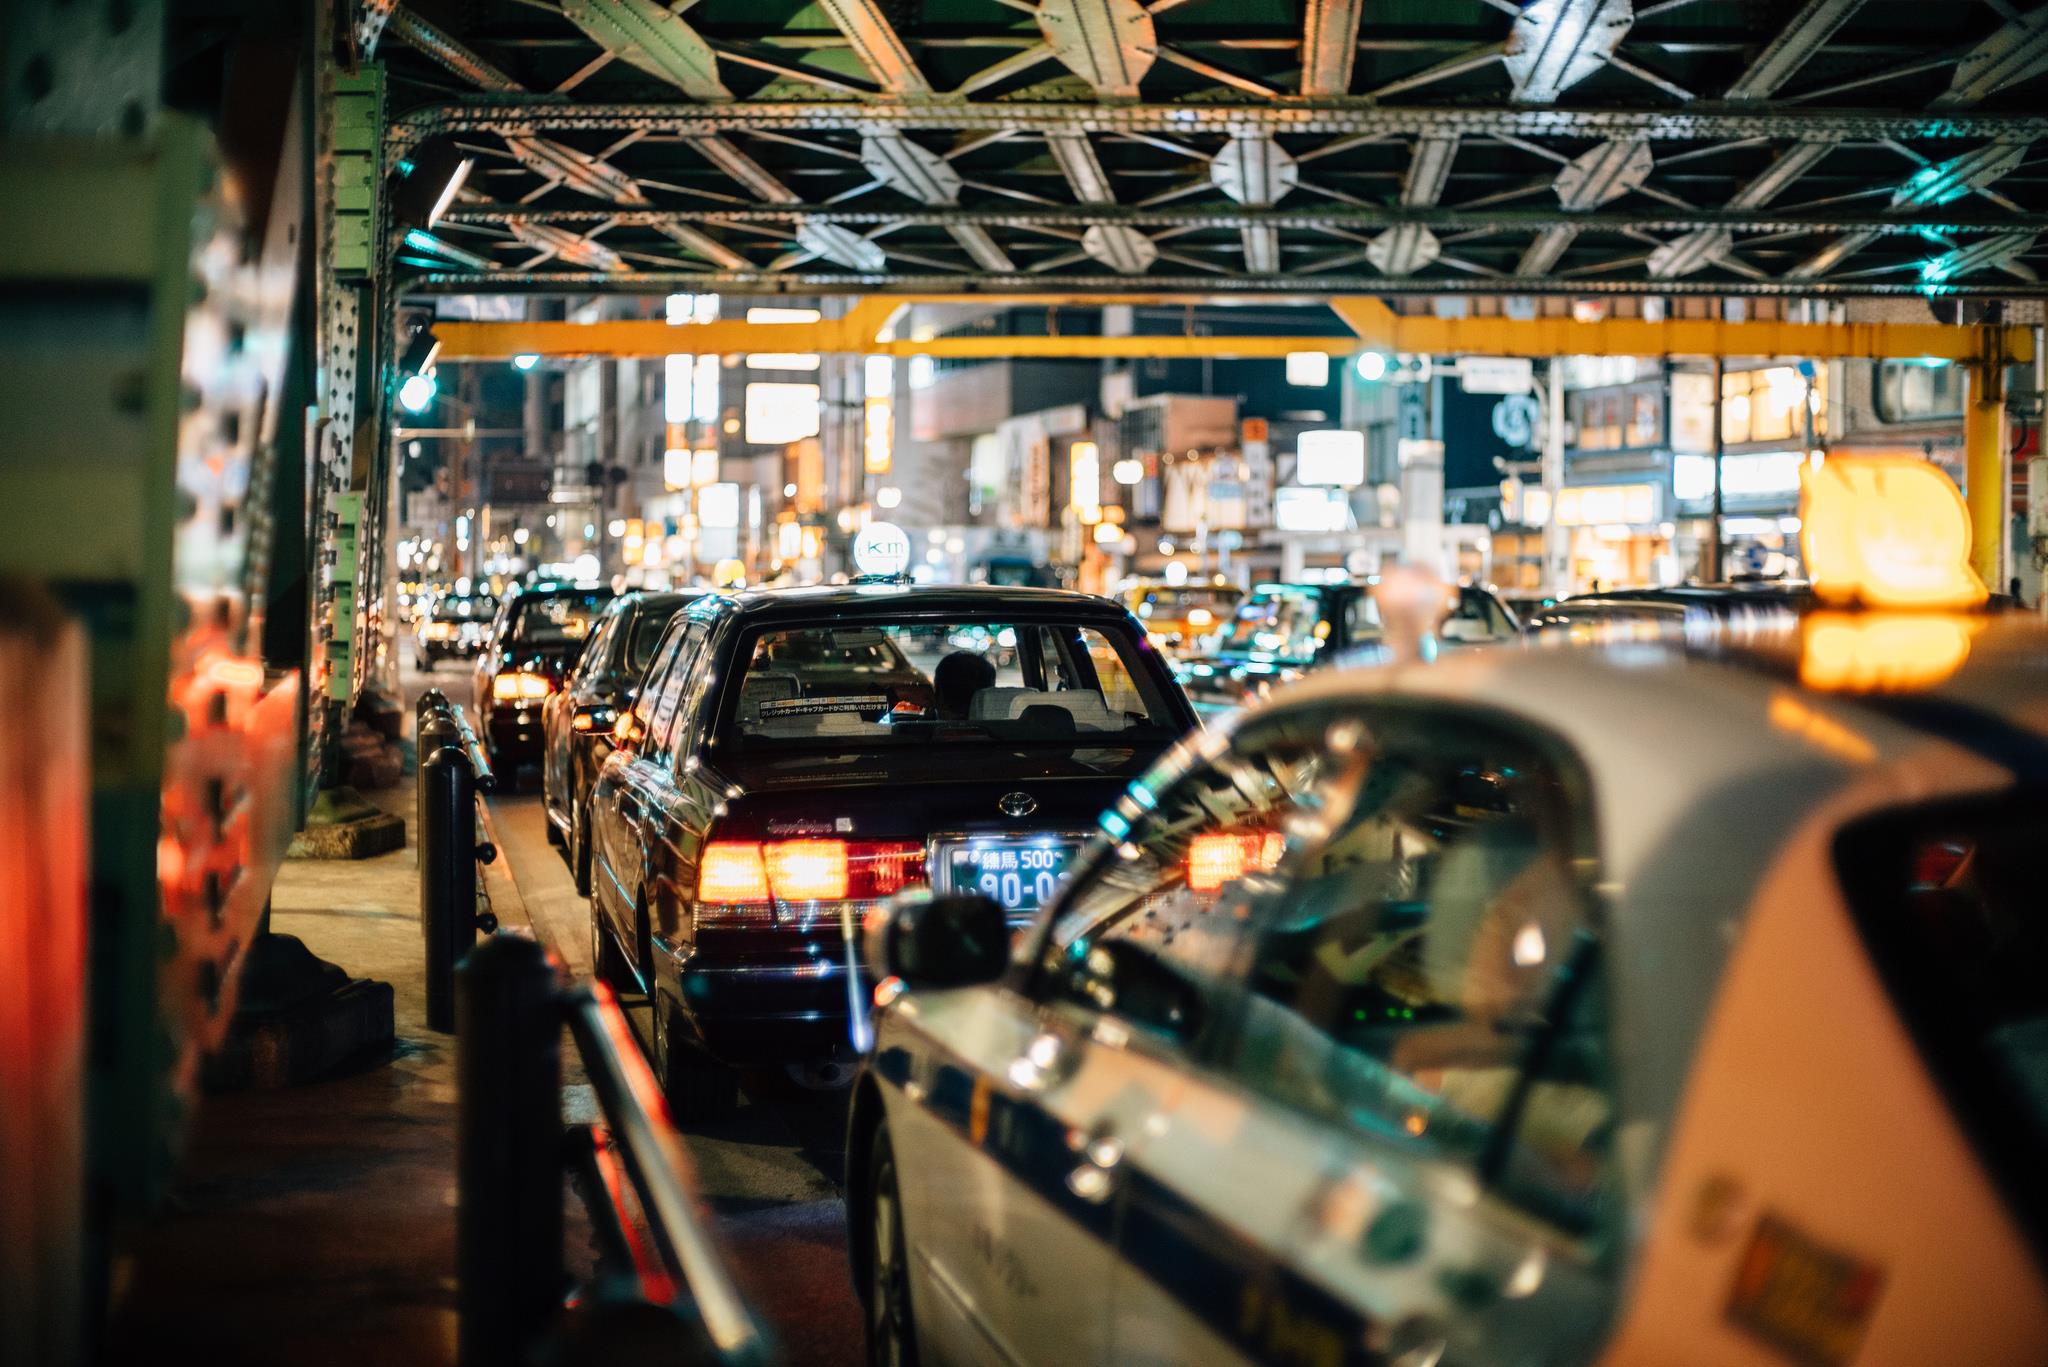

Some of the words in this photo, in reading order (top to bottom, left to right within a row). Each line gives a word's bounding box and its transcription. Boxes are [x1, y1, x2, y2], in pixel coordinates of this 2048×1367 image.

[981, 850, 1018, 869] 練馬
[1021, 849, 1054, 869] 500
[979, 871, 1072, 908] 90-0
